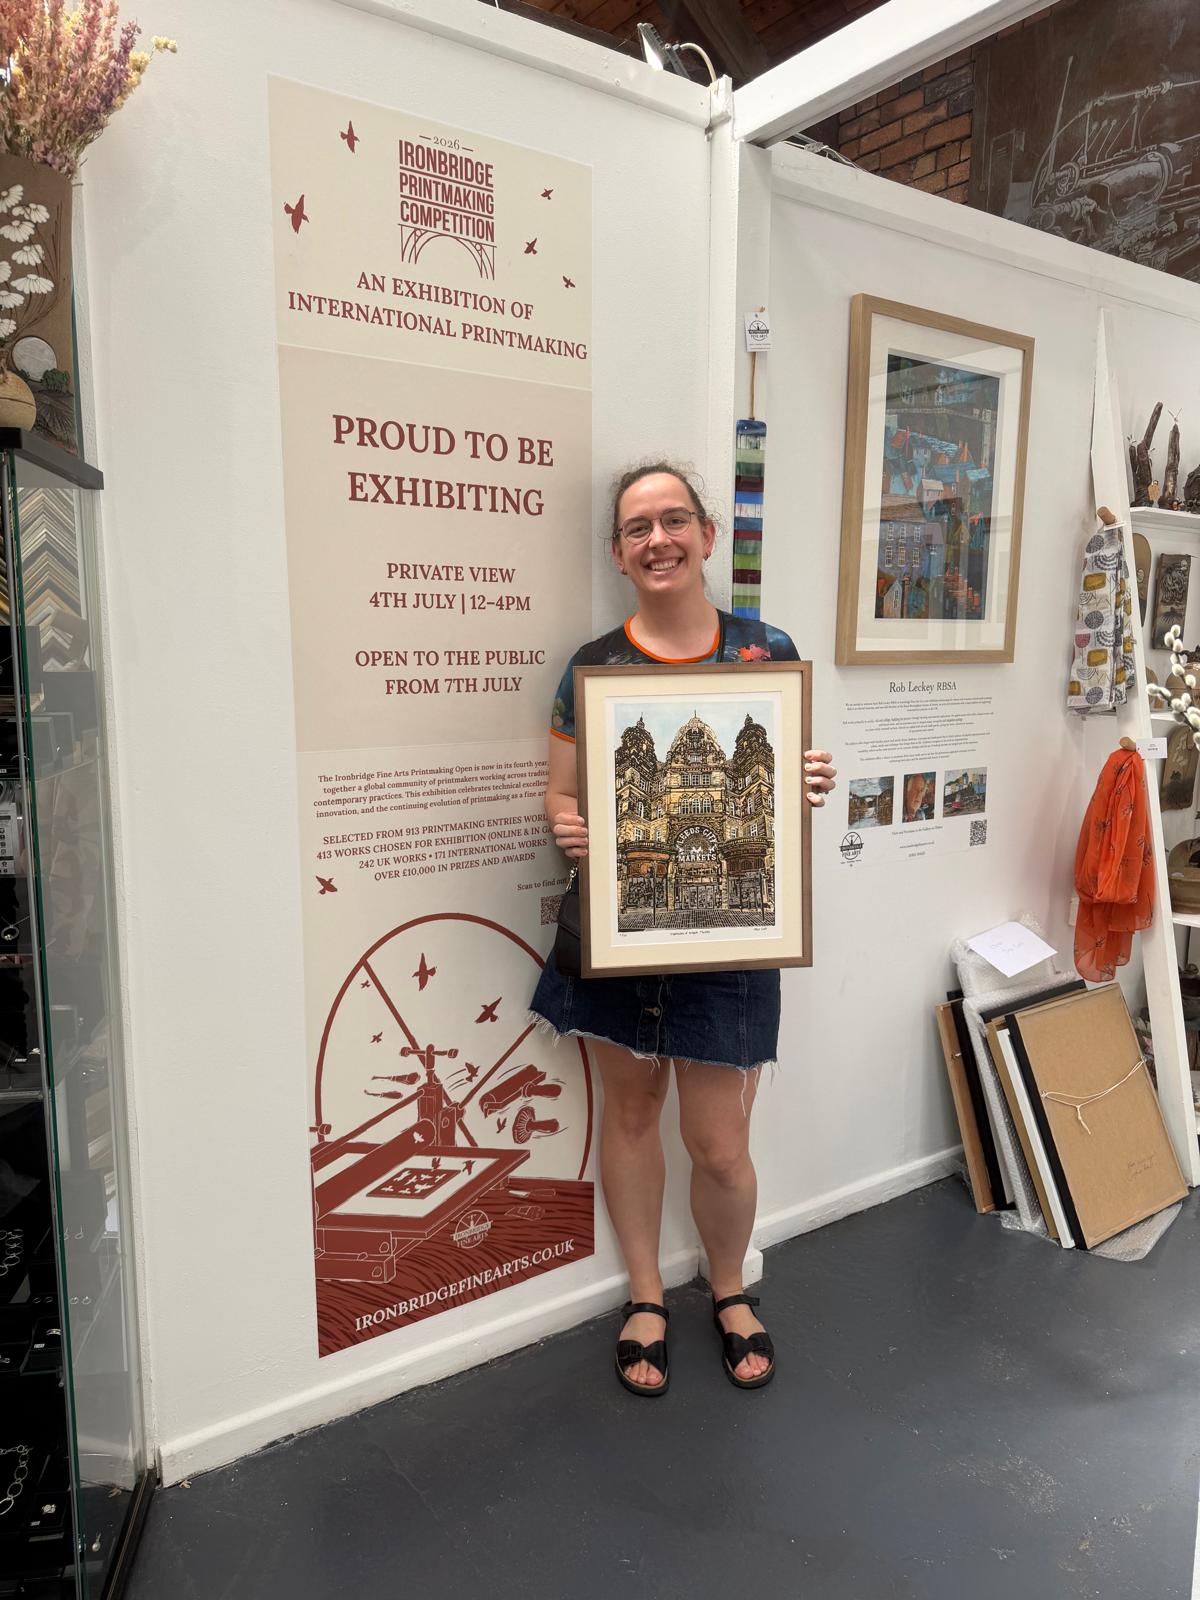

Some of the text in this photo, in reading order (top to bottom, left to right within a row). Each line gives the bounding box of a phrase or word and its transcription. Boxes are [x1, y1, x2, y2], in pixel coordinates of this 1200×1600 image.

[433, 136, 460, 151] 2026
[399, 139, 494, 188] IRONBRIDGE
[399, 172, 494, 215] PRINTMAKING
[400, 200, 495, 242] COMPETITION
[357, 271, 534, 321] AN EXHIBITION OF
[288, 291, 588, 360] INTERNATIONAL PRINTMAKING
[332, 414, 554, 467] PROUD TO BE
[347, 471, 545, 516] EXHIBITING
[386, 562, 516, 583] PRIVATE VIEW
[369, 591, 408, 608] 4TH
[412, 593, 456, 609] JULY
[355, 650, 546, 667] OPEN TO THE PUBLIC
[385, 677, 523, 695] FROM 7TH JULY
[889, 681, 957, 694] Rob Leckey RBSA
[318, 775, 333, 783] The
[335, 772, 375, 782] Ironbridge
[376, 771, 393, 779] Fine
[410, 766, 454, 776] Printmaking
[455, 765, 473, 774] Open
[496, 762, 503, 770] in
[513, 760, 534, 768] fourth
[323, 785, 356, 795] together
[363, 782, 386, 792] global
[387, 779, 428, 789] community
[428, 778, 436, 786] of
[437, 775, 478, 786] printmakers
[480, 772, 506, 782] working
[313, 796, 368, 807] contemporary
[369, 793, 403, 804] practices.
[405, 790, 420, 798] This
[422, 788, 457, 797] exhibition
[458, 785, 492, 794] celebrates
[492, 782, 521, 791] technical
[316, 808, 360, 818] innovation,
[360, 806, 374, 814] and
[389, 801, 429, 811] continuing
[430, 798, 461, 808] evolution
[462, 796, 470, 804] of
[470, 793, 511, 805] printmaking
[524, 790, 537, 798] fine
[316, 850, 332, 860] 413
[334, 846, 371, 858] WORKS
[372, 841, 412, 854] CHOSEN
[414, 839, 433, 849] FOR
[434, 832, 487, 847] EXHIBITION
[488, 829, 522, 842] (ONLINE
[523, 828, 530, 836] &
[531, 826, 540, 835] IN
[323, 813, 549, 845] SELECTED FROM 913 PRINTMAKING ENTRIES WORL
[677, 826, 718, 844] LEEDS CITY
[359, 859, 375, 869] 242
[377, 858, 391, 867] UK
[393, 853, 427, 864] WORKS
[434, 850, 446, 860] 171
[448, 841, 517, 858] INTERNATIONAL
[518, 838, 548, 850] WORKS
[374, 852, 536, 882] OVER £10,000 IN PRIZES AND AWARDS
[678, 853, 717, 862] MARKETS
[517, 883, 533, 891] Scan
[542, 878, 556, 888] find
[354, 1238, 575, 1332] IRONBRIDGEFINEARTS.CO.UK
